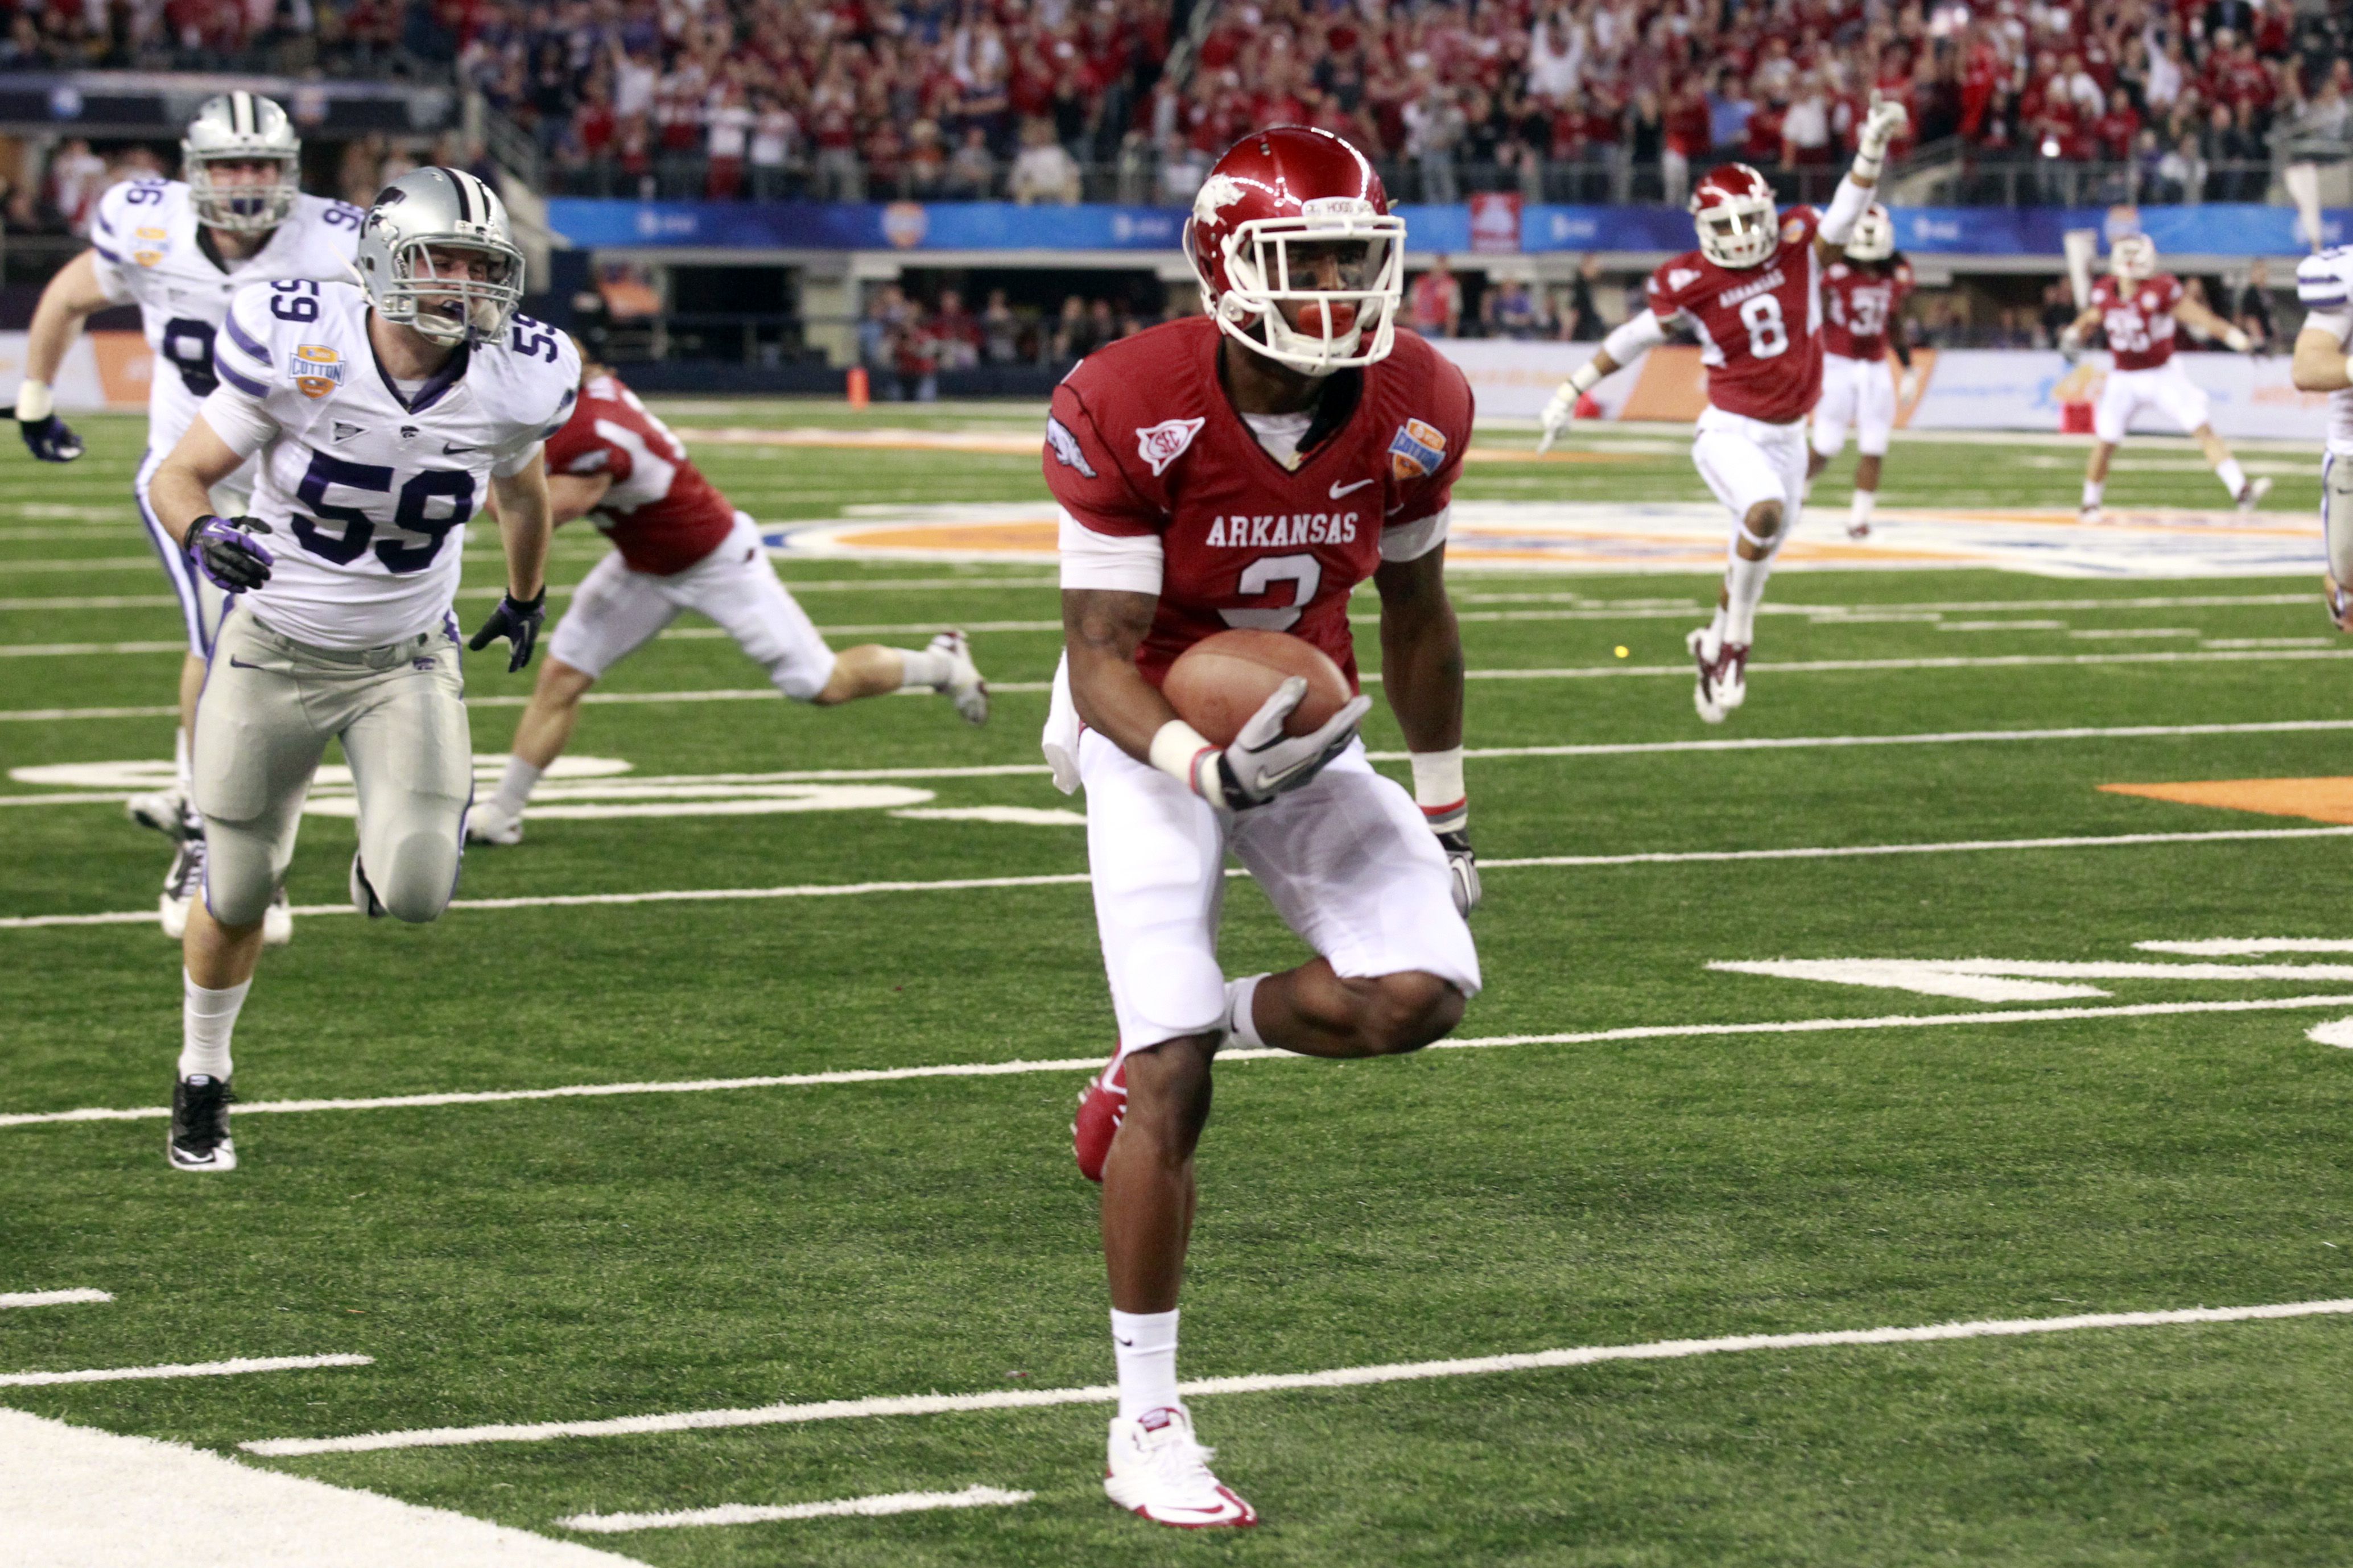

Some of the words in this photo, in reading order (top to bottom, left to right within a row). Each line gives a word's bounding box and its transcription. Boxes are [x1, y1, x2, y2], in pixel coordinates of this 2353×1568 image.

[1740, 293, 1789, 359] 8
[292, 357, 342, 383] COTTON
[1155, 430, 1180, 453] SEC
[290, 448, 476, 573] 59
[1206, 512, 1359, 547] ARKANSAS
